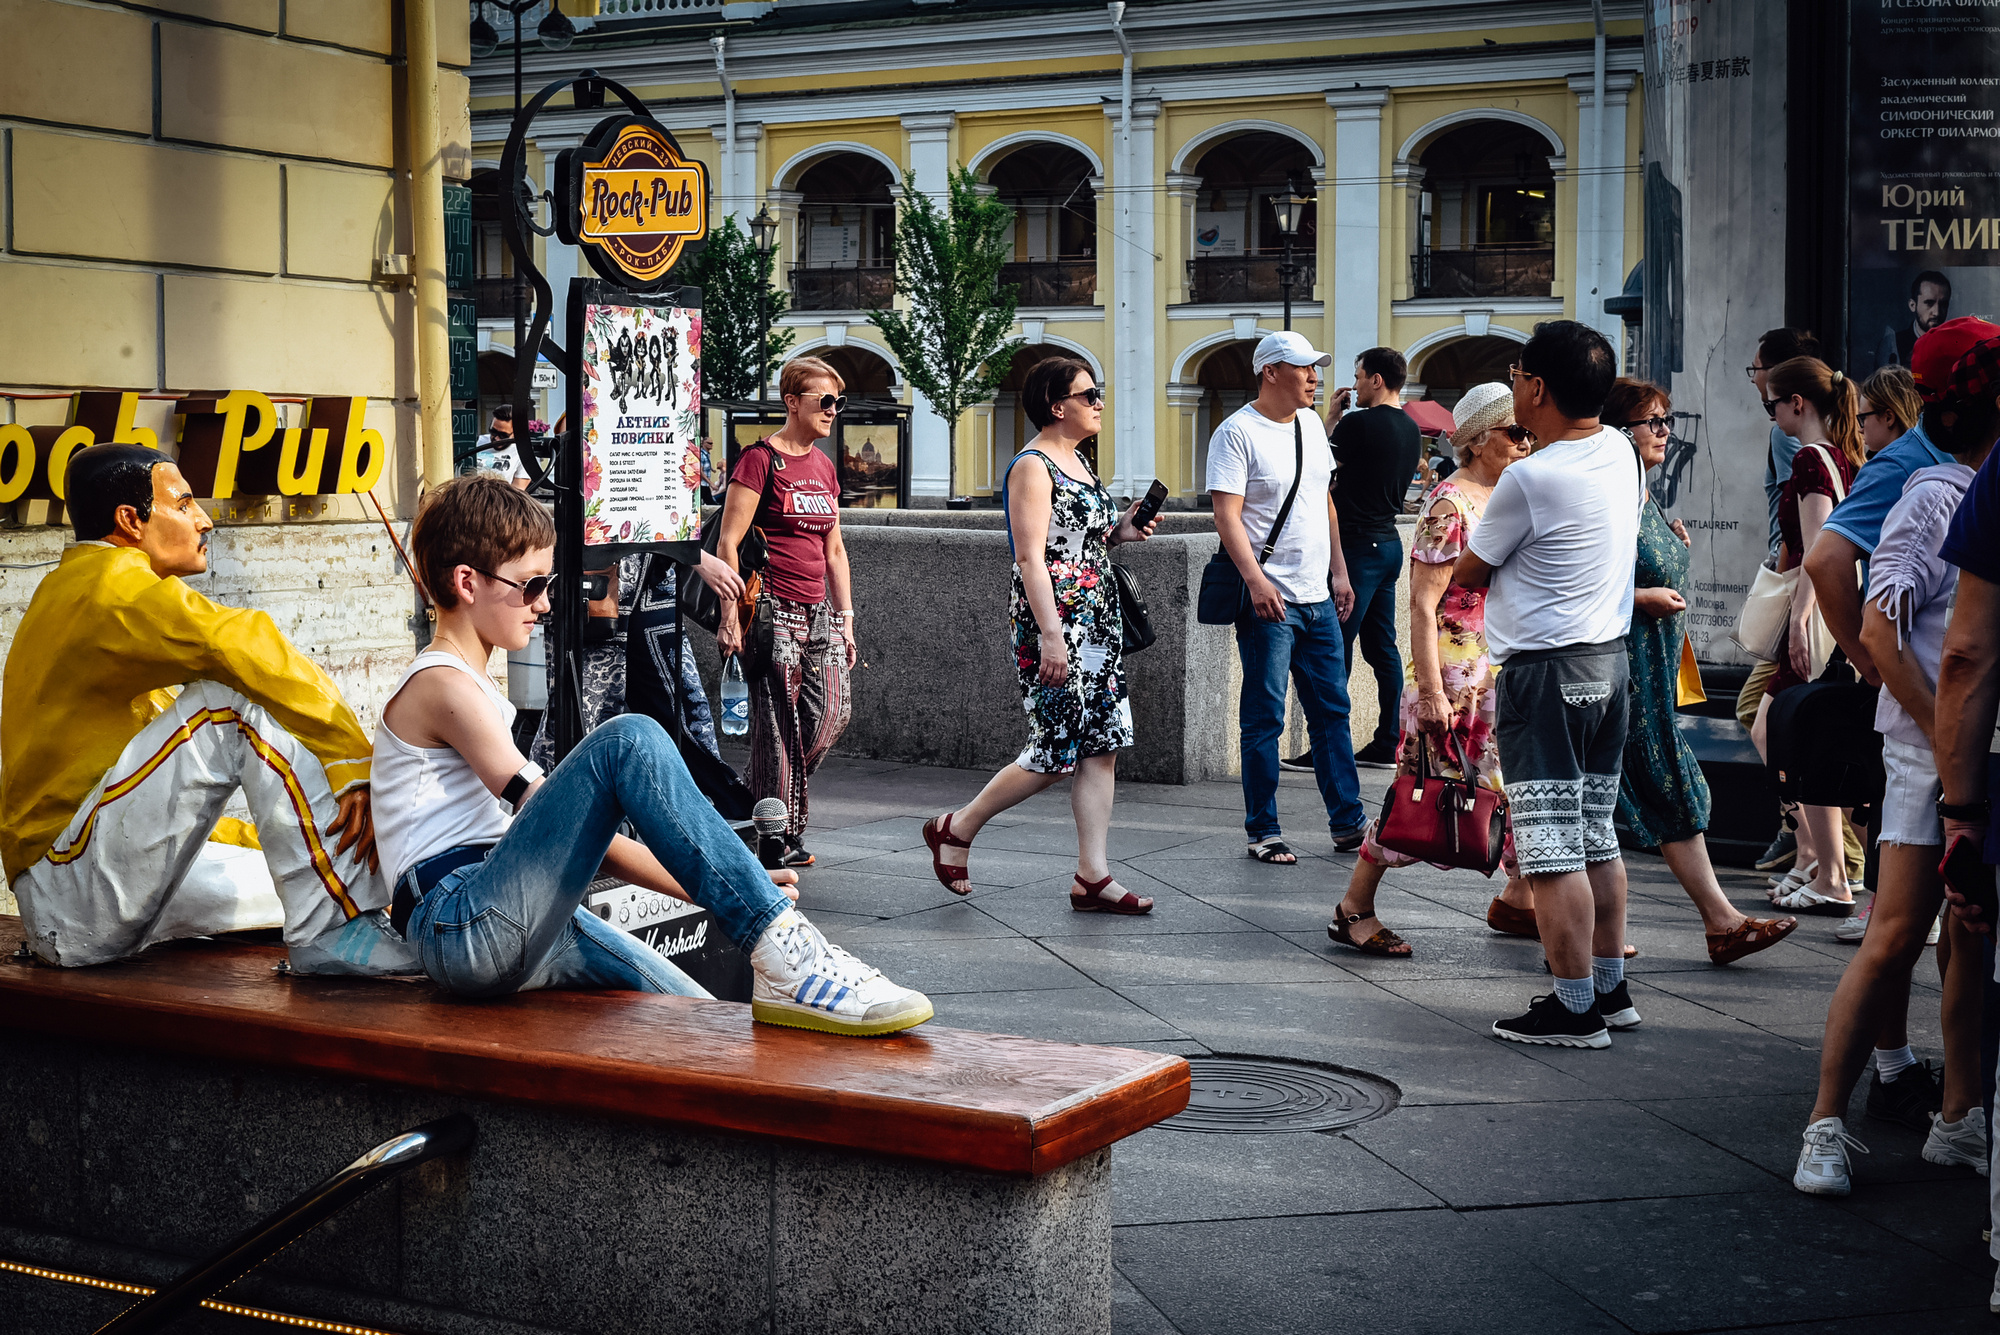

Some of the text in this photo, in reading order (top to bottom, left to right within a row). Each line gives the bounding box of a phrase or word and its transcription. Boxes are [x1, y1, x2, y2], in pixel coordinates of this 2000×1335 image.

[1896, 0, 1952, 8] СЕЗОНА
[1880, 76, 2000, 90] Заслуженный коллект
[1880, 94, 1967, 104] академический
[1880, 109, 1994, 121] СИМФОНИЧЕСКИЙ
[1880, 127, 1934, 139] ОРКЕСТР
[611, 140, 669, 166] НЕВСКИЙ 38
[1942, 171, 1987, 179] руководитель
[592, 177, 693, 226] Rock-Pub
[1882, 184, 1965, 215] Юрий
[619, 247, 668, 267] РОК-ПАБ
[616, 416, 670, 429] ЛЕТНИЕ
[212, 389, 385, 499] Pub
[611, 432, 674, 445] НОВИНКИ
[212, 501, 328, 520] ВНОЙ БАР
[1698, 520, 1739, 530] LAURENT
[1694, 579, 1749, 594] Ассортимент
[1686, 613, 1738, 628] 1027739063
[645, 919, 708, 958] Marshall
